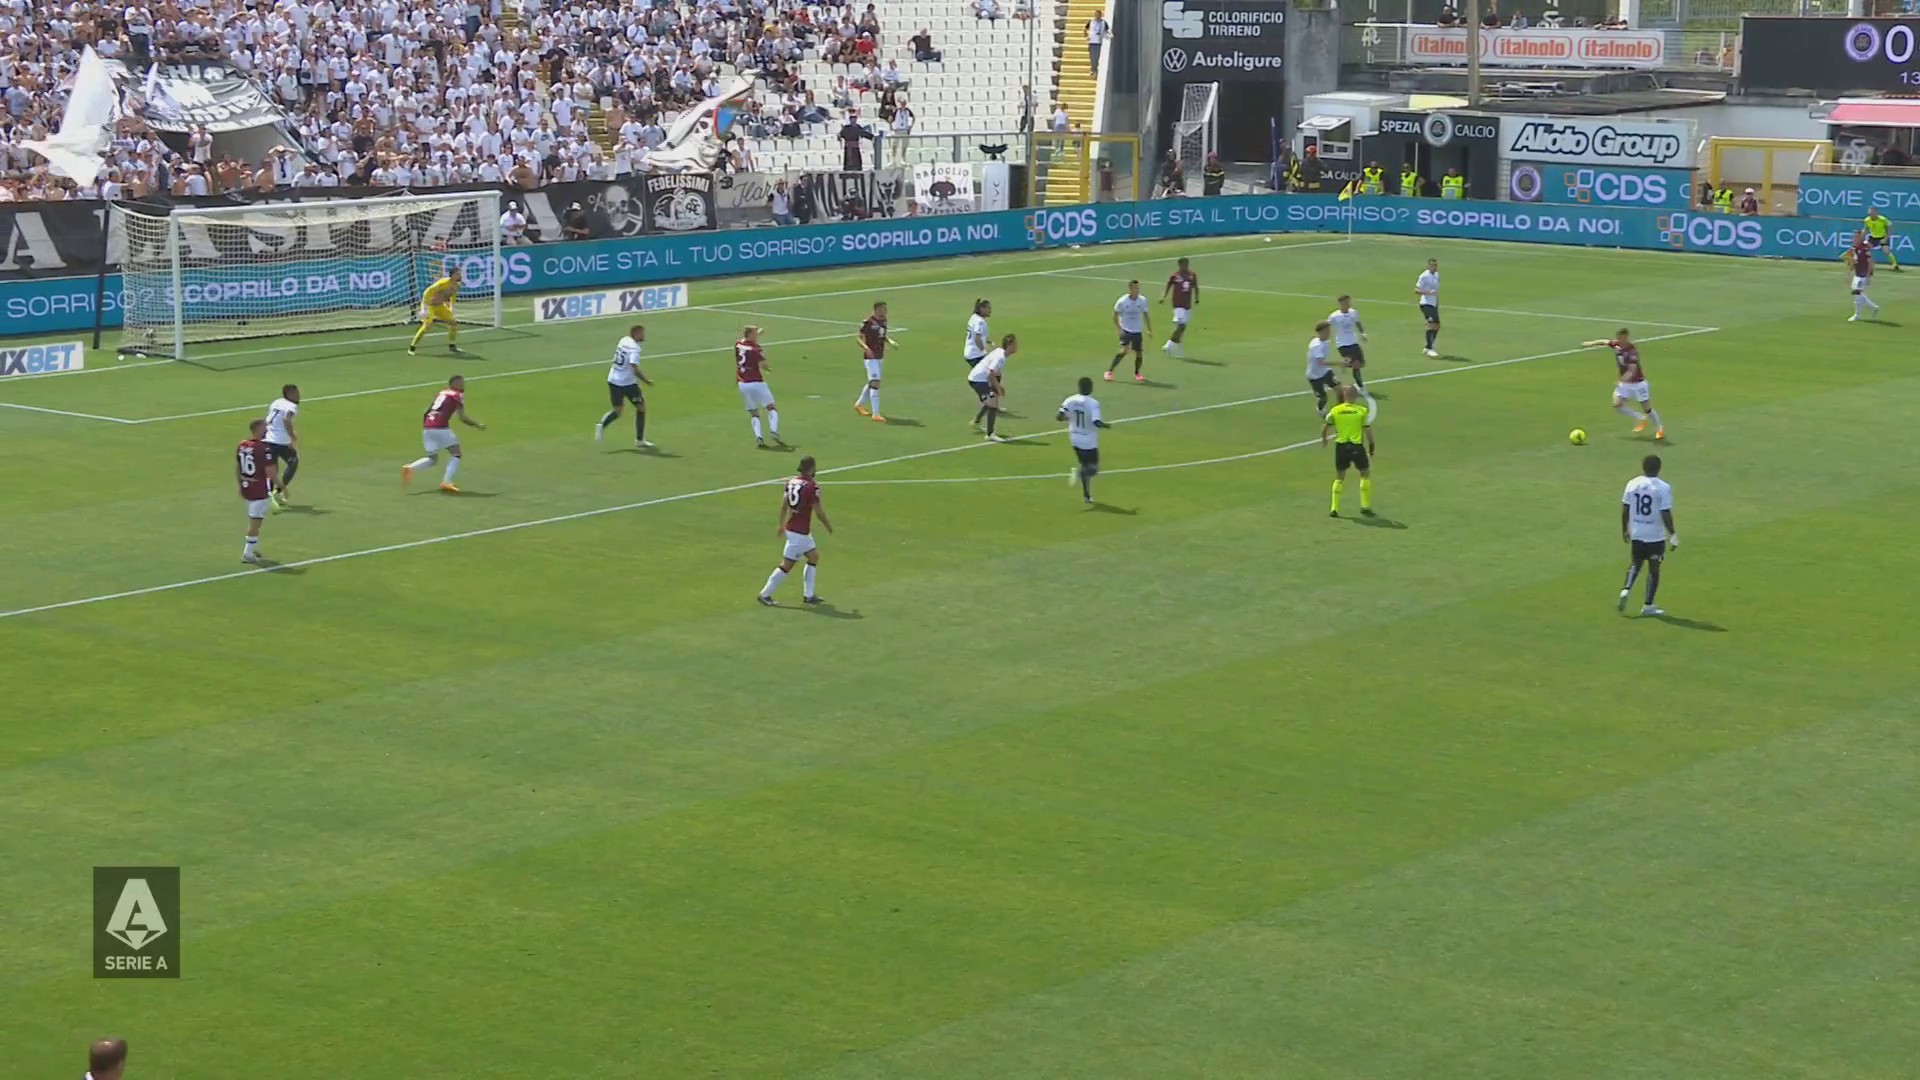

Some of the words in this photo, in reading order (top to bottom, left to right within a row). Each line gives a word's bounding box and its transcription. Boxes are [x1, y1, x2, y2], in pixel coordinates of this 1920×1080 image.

[1208, 11, 1284, 24] COLORIFICIO
[1208, 25, 1261, 36] TIRRENO
[1500, 38, 1566, 56] italnolo
[1584, 39, 1653, 58] italnolo
[1885, 24, 1915, 63] 0
[1192, 50, 1282, 71] Autoligure
[1380, 120, 1422, 134] SPEZIA
[1454, 123, 1496, 138] CALCIO
[1592, 125, 1681, 163] Group
[647, 175, 710, 193] FEDELISSIMI
[1594, 172, 1668, 203] CDS
[1047, 208, 1098, 240] CDS
[1105, 210, 1163, 229] COME
[1168, 209, 1205, 224] STA
[1211, 209, 1226, 222] IL
[1231, 205, 1280, 221] TUO
[1287, 205, 1410, 222] SORRISO?
[1416, 209, 1531, 230] SCOPRILO
[1538, 213, 1571, 231] DA
[1687, 216, 1763, 250] CDS
[1775, 228, 1856, 248] COME
[460, 251, 532, 289] CDS
[543, 253, 610, 275] COME
[617, 251, 659, 270] STA
[666, 249, 681, 265] IL
[688, 244, 733, 262] TUO
[739, 235, 837, 260] SORRISO?
[841, 228, 933, 251] SCOPRILO
[937, 227, 962, 244] DA
[165, 278, 300, 305] SCOPRILO
[306, 275, 340, 294] DA
[541, 293, 607, 320] 1XBET
[618, 285, 682, 312] 1XBET
[1074, 409, 1086, 429] 11
[239, 452, 256, 475] 16
[1633, 493, 1653, 516] 18
